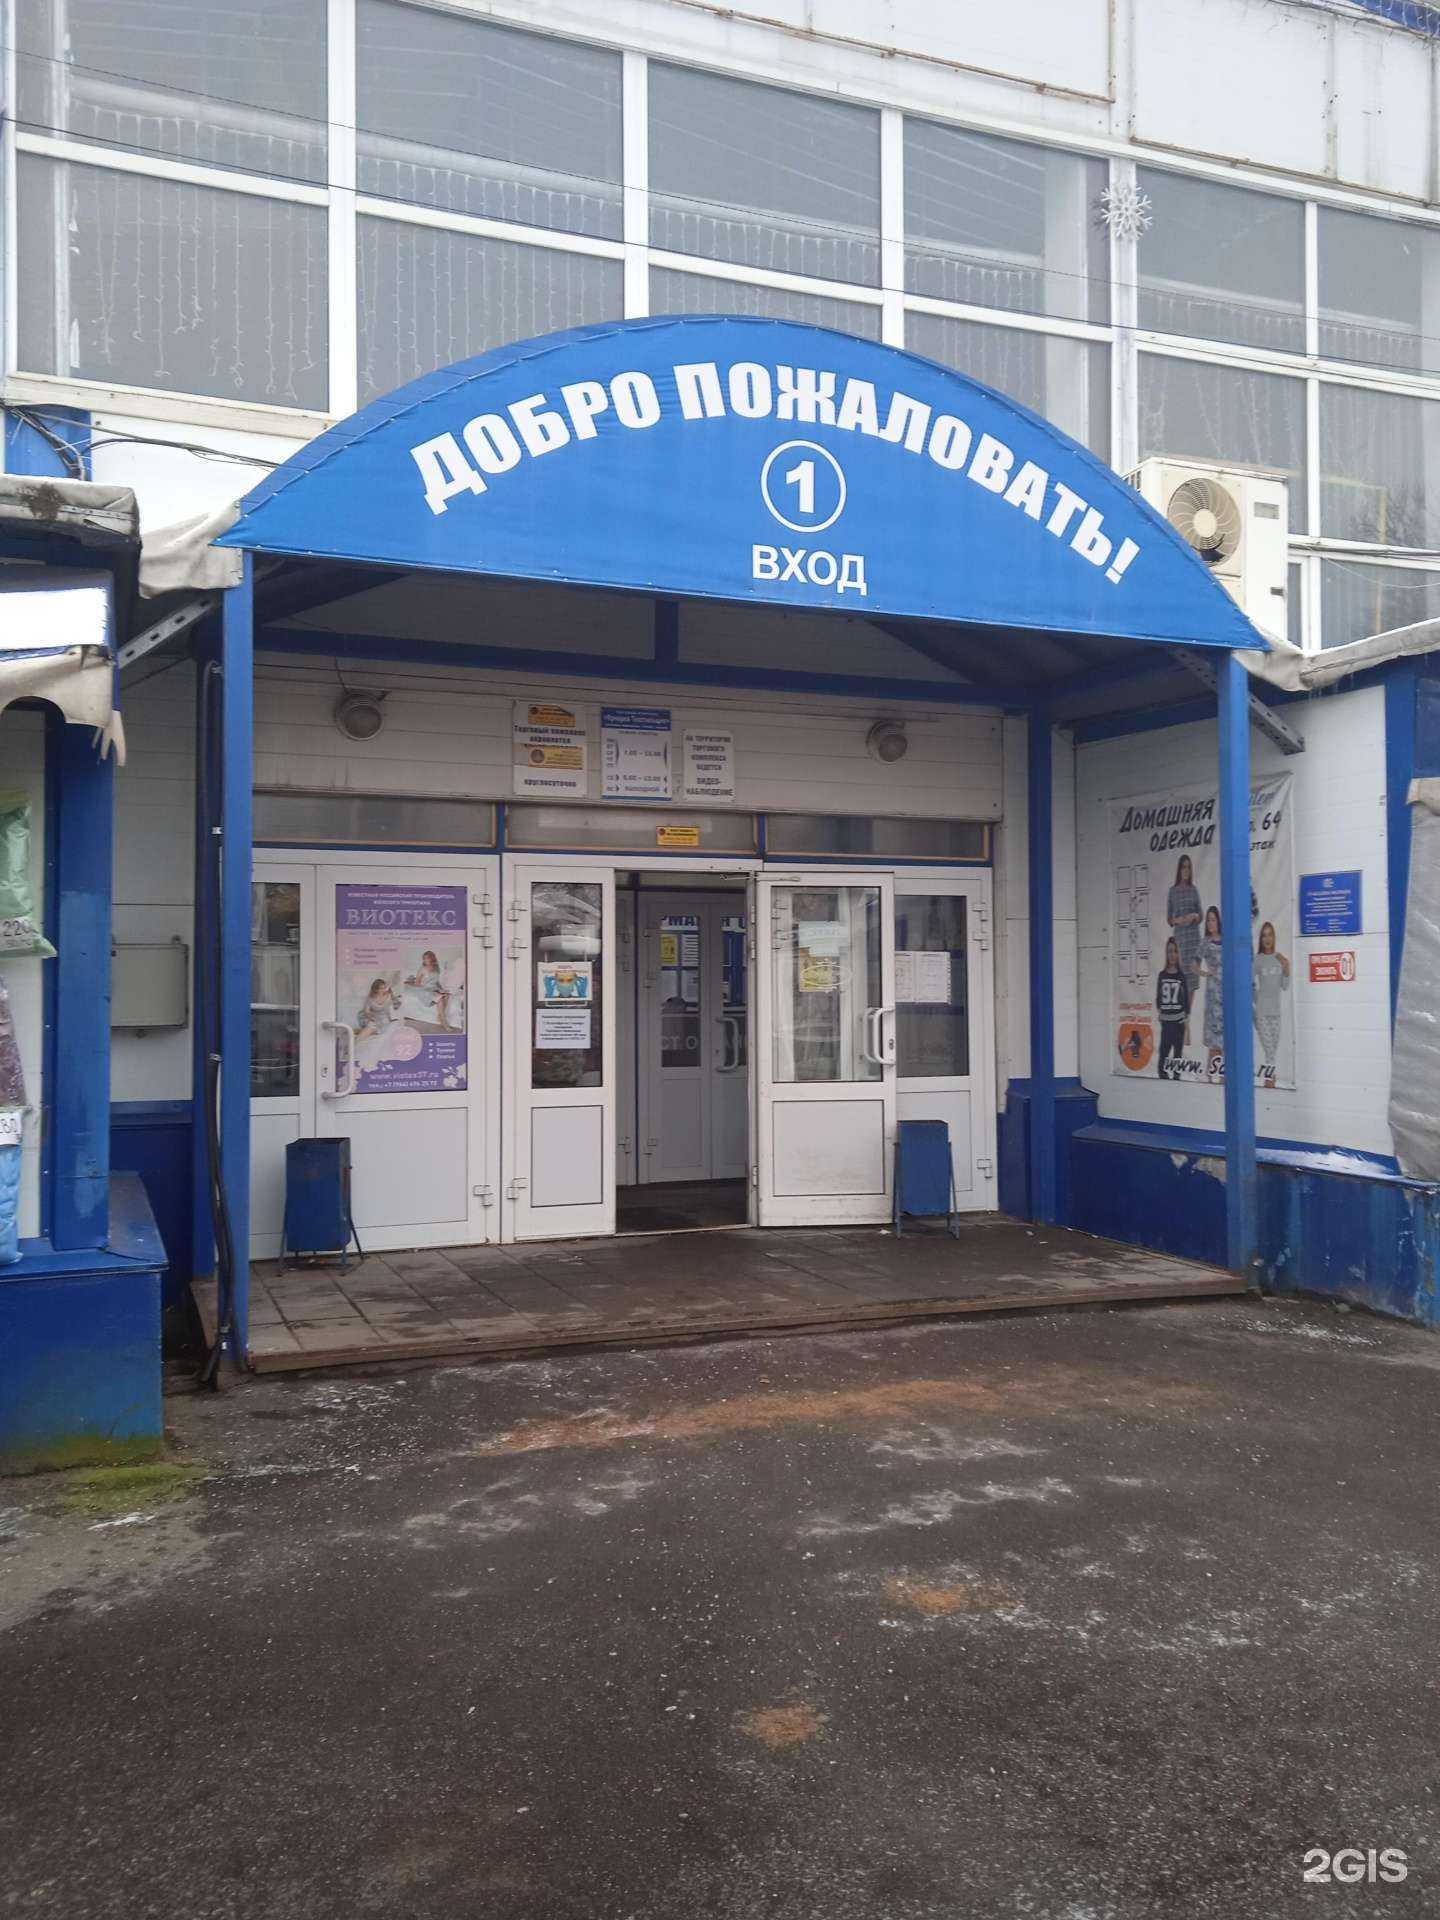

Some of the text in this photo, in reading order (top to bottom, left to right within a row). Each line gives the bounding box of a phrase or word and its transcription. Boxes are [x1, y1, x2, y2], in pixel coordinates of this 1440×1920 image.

[410, 362, 1140, 585] ДОБРО ПОЖАЛОВАТЬ!
[786, 461, 815, 514] 1
[752, 544, 867, 596] ВХОД
[1118, 798, 1216, 834] Домашняя
[1150, 824, 1216, 852] одежда
[345, 909, 457, 926] ВИОТЕКС
[1162, 982, 1180, 1003] 97
